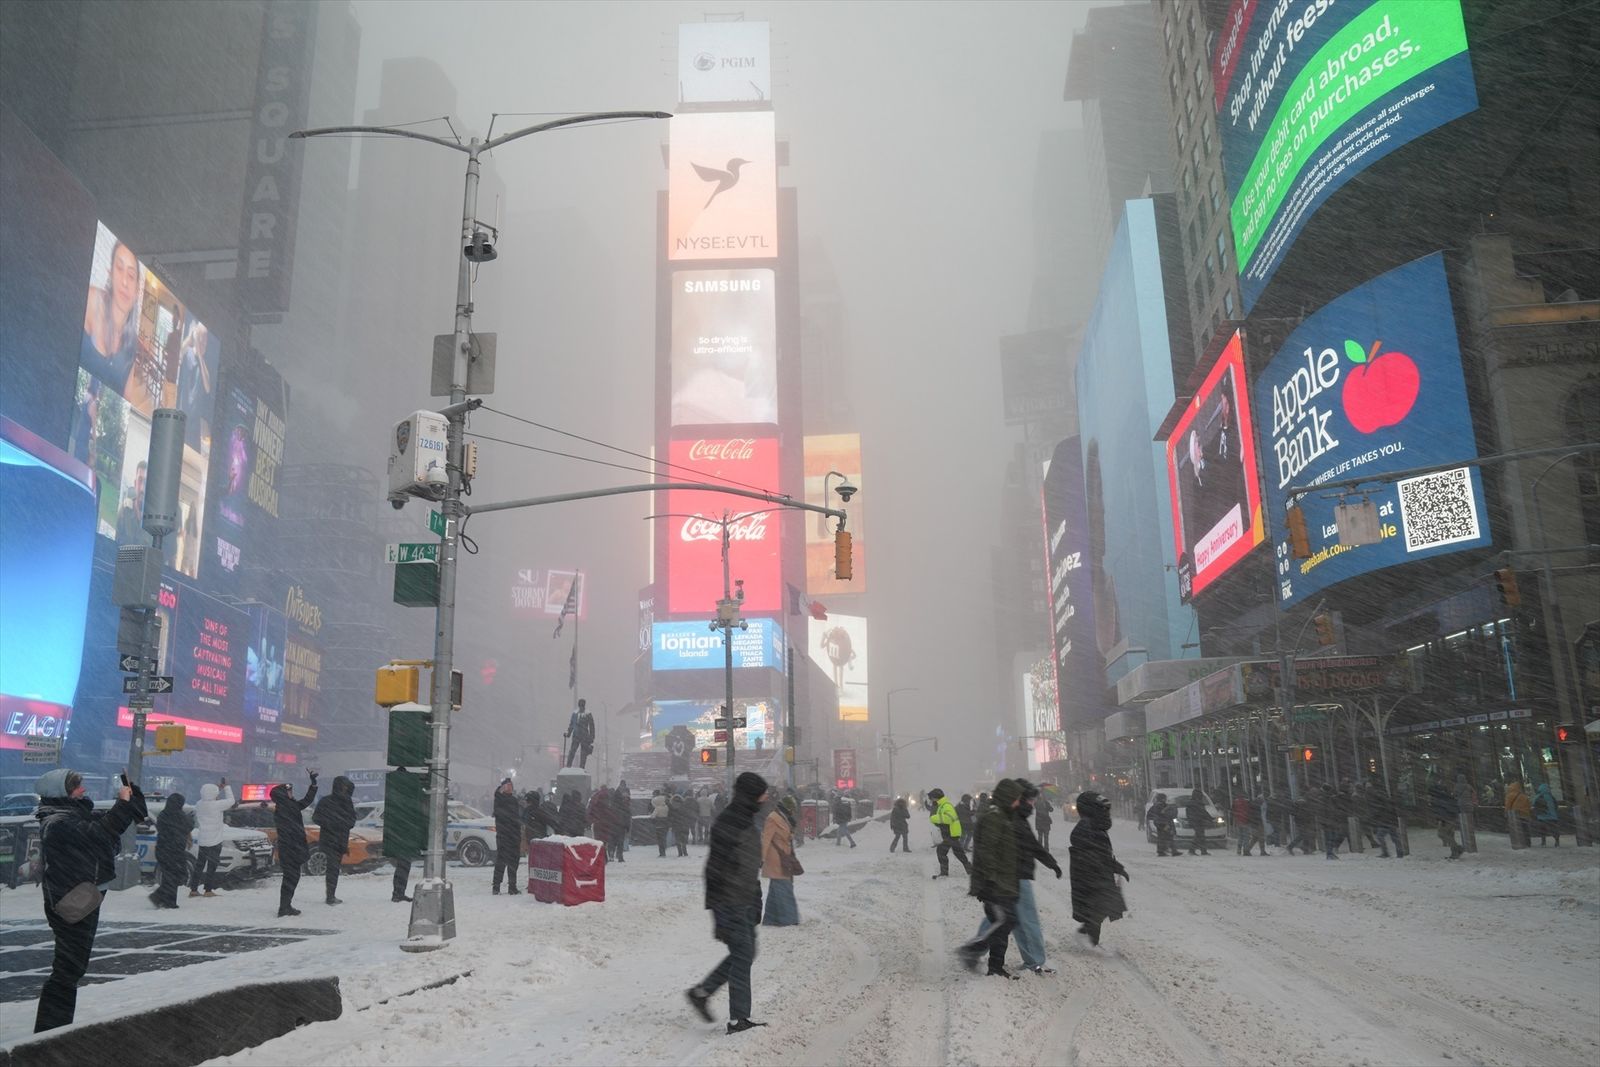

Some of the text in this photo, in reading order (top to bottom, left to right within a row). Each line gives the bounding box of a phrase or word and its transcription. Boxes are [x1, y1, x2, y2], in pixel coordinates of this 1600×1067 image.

[1221, 8, 1243, 75] Simple
[721, 57, 756, 68] PGIM
[1231, 72, 1251, 126] Shop
[1248, 42, 1286, 131] without
[1242, 14, 1399, 217] Use your debit card abroad,
[1342, 117, 1377, 145] reimburse
[1377, 108, 1387, 121] all
[1387, 83, 1435, 113] surcharges
[1242, 38, 1421, 248] and pay no fees on purchases.
[1326, 145, 1355, 171] statement
[1355, 130, 1373, 146] cycle
[1374, 112, 1403, 135] period.
[1345, 132, 1391, 167] Transactions.
[248, 67, 289, 279] SQUARE
[676, 236, 769, 250] NYSE:EVTL
[685, 279, 761, 293] SAMSUNG
[711, 335, 738, 347] drying
[1272, 346, 1340, 438] Apple
[689, 438, 755, 461] Coca-Cola
[1274, 405, 1339, 489] Bank
[1315, 441, 1405, 488] WHERE LIFE TAKES YOU.
[256, 448, 275, 487] BEST
[248, 472, 279, 519] MUSICAL
[1380, 500, 1395, 517] at
[400, 546, 408, 561] W
[412, 546, 425, 560] 46
[193, 647, 232, 668] CAPTIVATING
[200, 632, 211, 647] THE
[661, 633, 722, 650] Ionian
[680, 649, 708, 658] Islands
